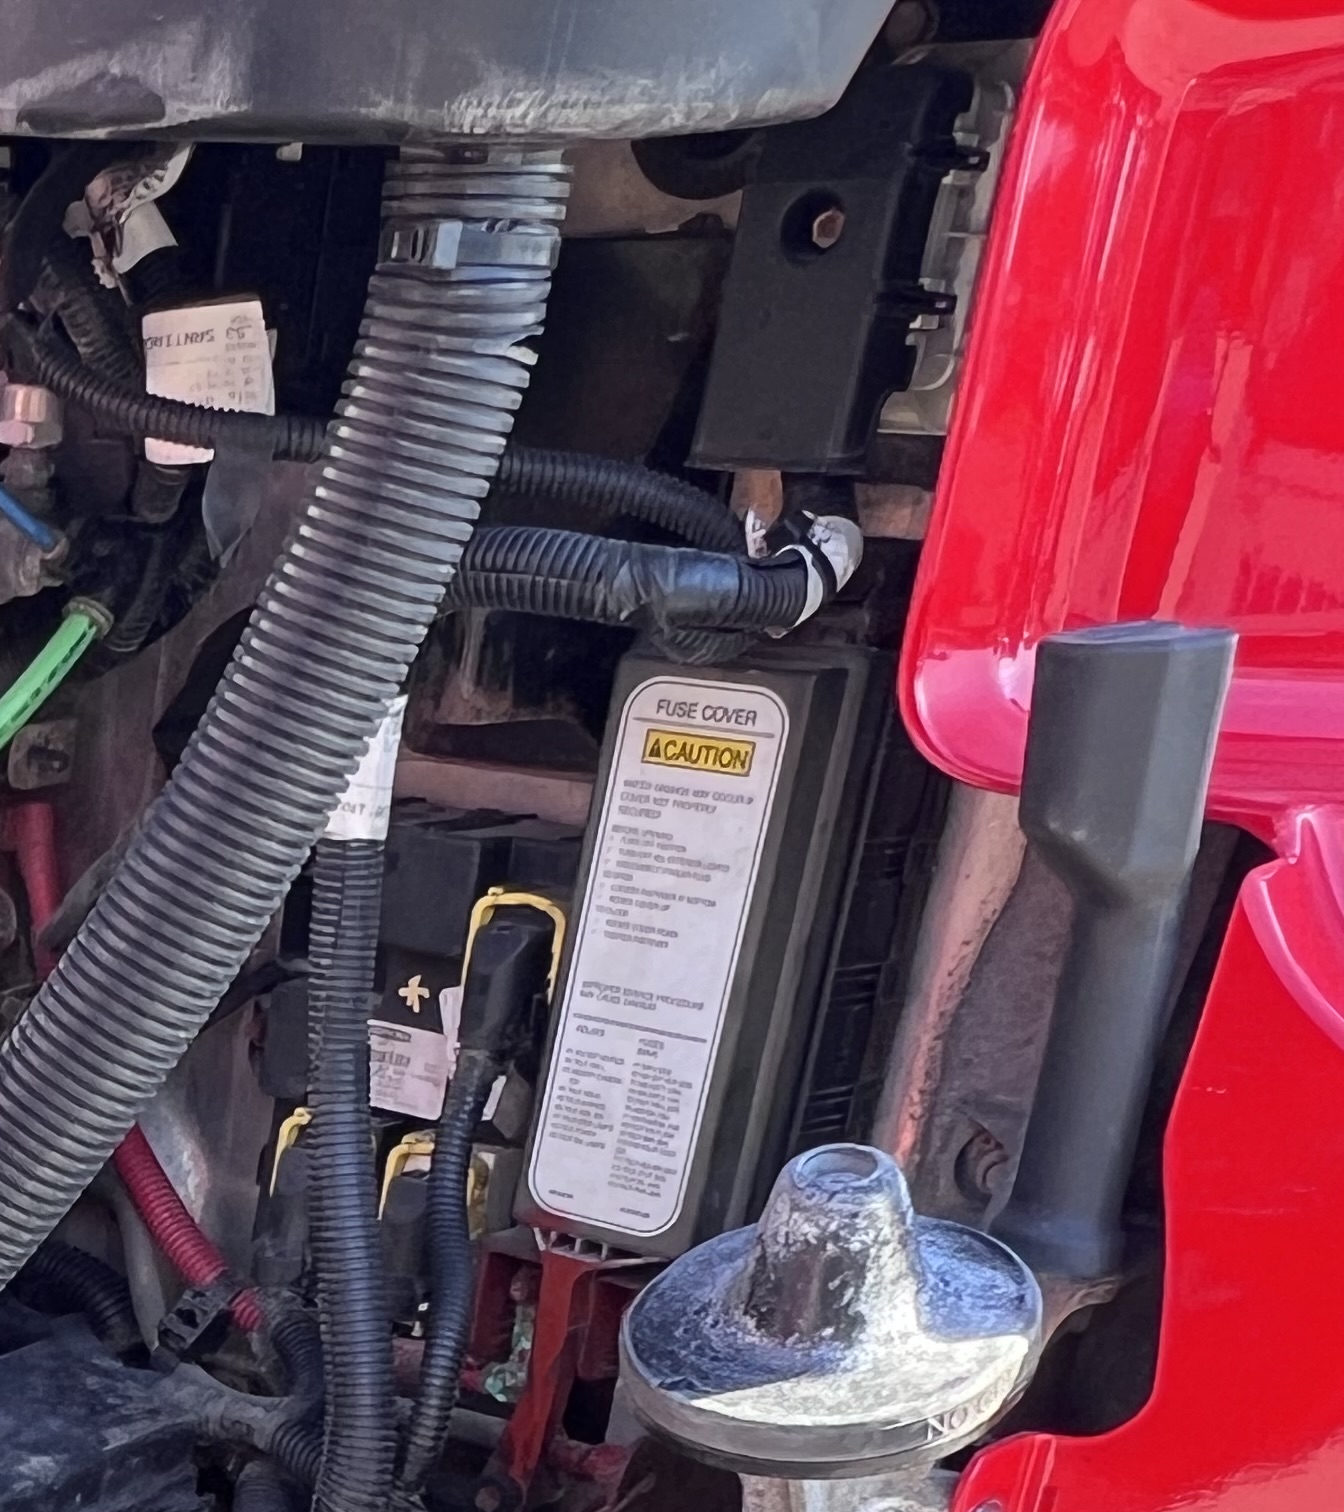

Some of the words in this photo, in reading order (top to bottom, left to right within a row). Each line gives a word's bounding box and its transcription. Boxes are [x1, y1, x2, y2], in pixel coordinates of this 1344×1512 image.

[656, 699, 699, 719] FUSE
[702, 704, 758, 727] COVER
[664, 740, 750, 770] CAUTION
